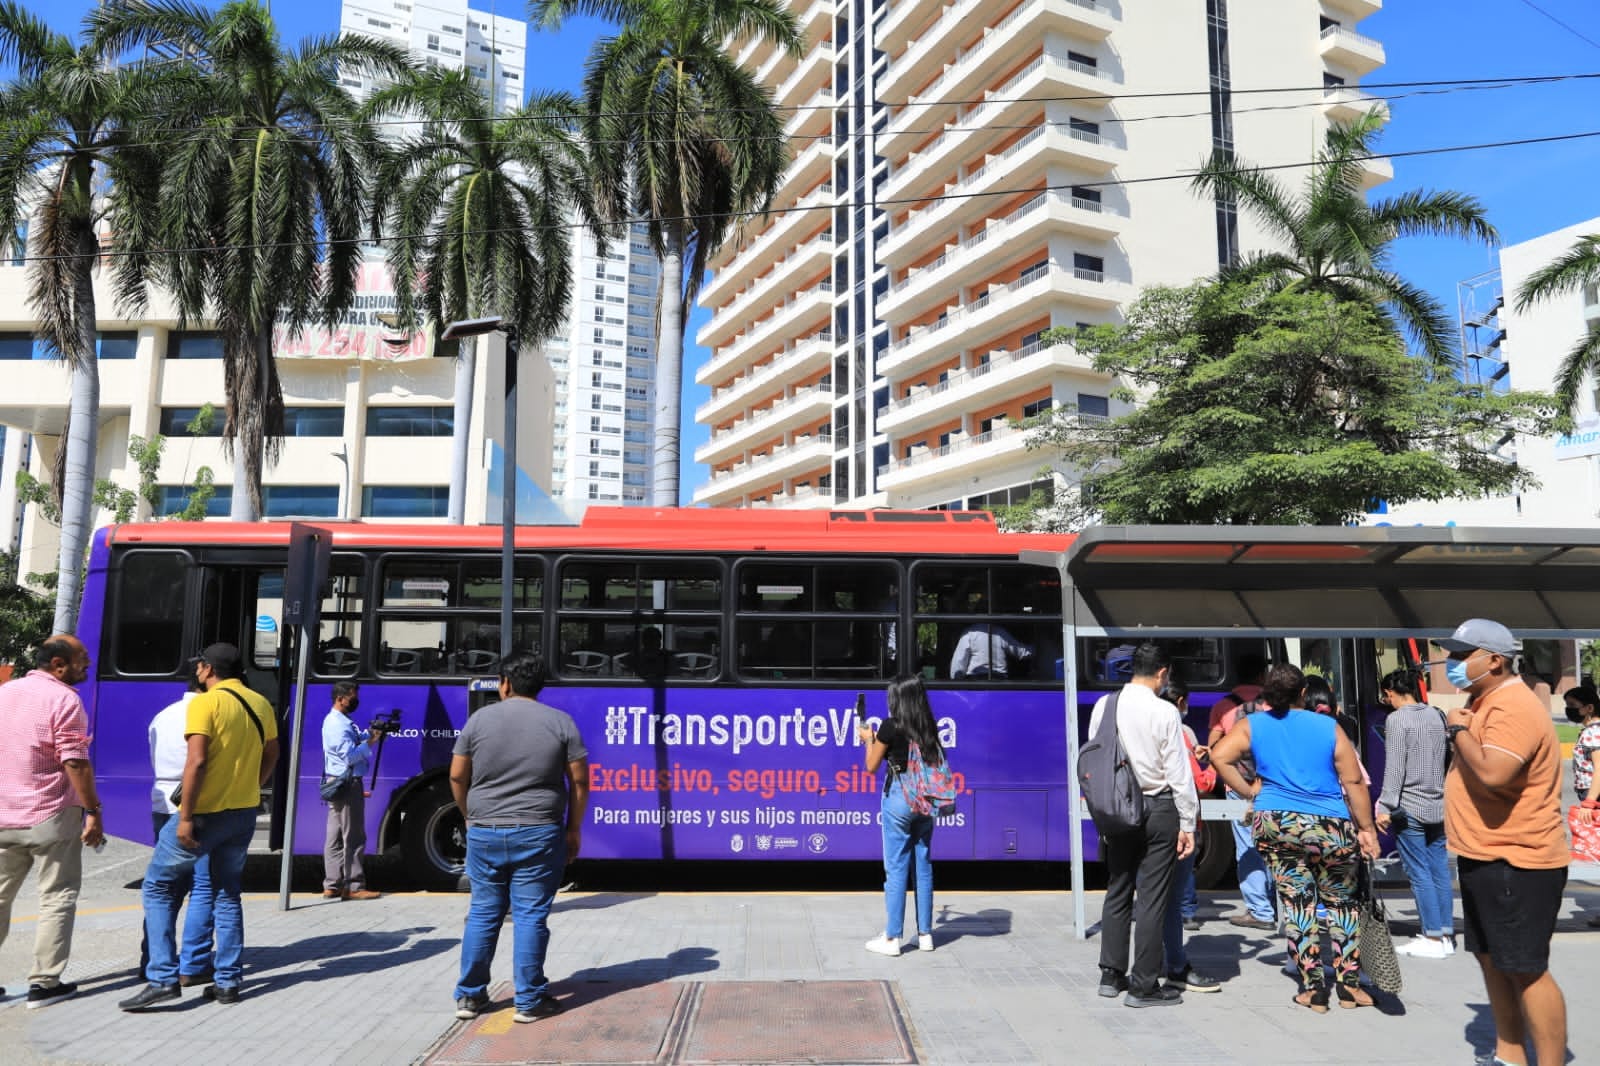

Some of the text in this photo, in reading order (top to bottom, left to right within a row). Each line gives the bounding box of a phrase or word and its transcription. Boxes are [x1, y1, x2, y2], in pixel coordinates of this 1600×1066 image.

[421, 729, 429, 738] Y
[588, 762, 877, 799] Exclusivo, seguro, sin
[594, 806, 630, 825] Para
[635, 806, 702, 828] mujeres
[706, 809, 716, 828] y
[720, 809, 751, 825] sus
[755, 806, 796, 829] hijos
[801, 809, 871, 825] menores
